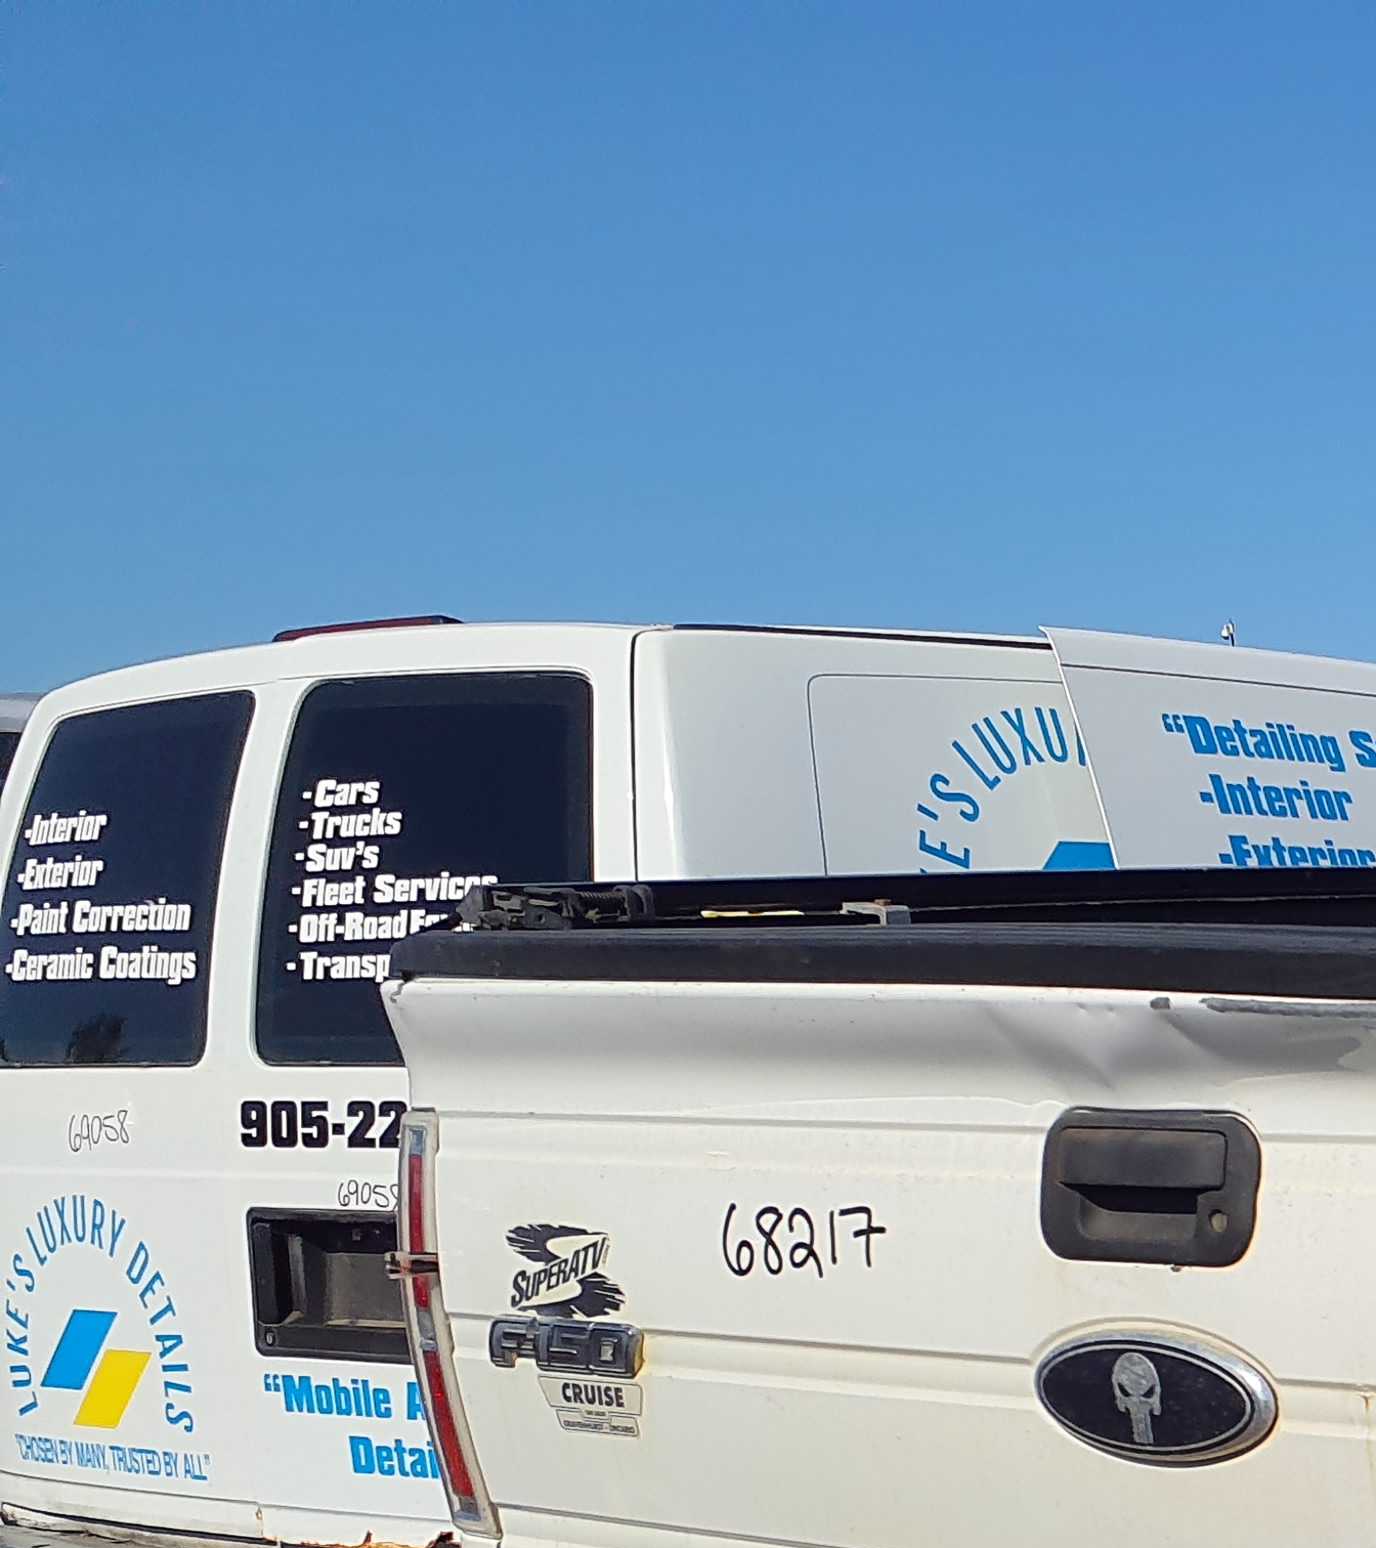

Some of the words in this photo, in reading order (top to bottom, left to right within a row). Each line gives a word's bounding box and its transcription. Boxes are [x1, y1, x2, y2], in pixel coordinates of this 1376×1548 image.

[72, 897, 192, 933] Correction
[99, 945, 197, 986] Coatings
[68, 1109, 130, 1153] 69058
[721, 1201, 887, 1279] 68217
[26, 1194, 127, 1267] LUXURY
[126, 1240, 195, 1434] DETAILS
[561, 1382, 625, 1409] CRUISE
[58, 1438, 74, 1465] BY
[109, 1445, 162, 1476] TRUSTED
[162, 1450, 181, 1478] BY
